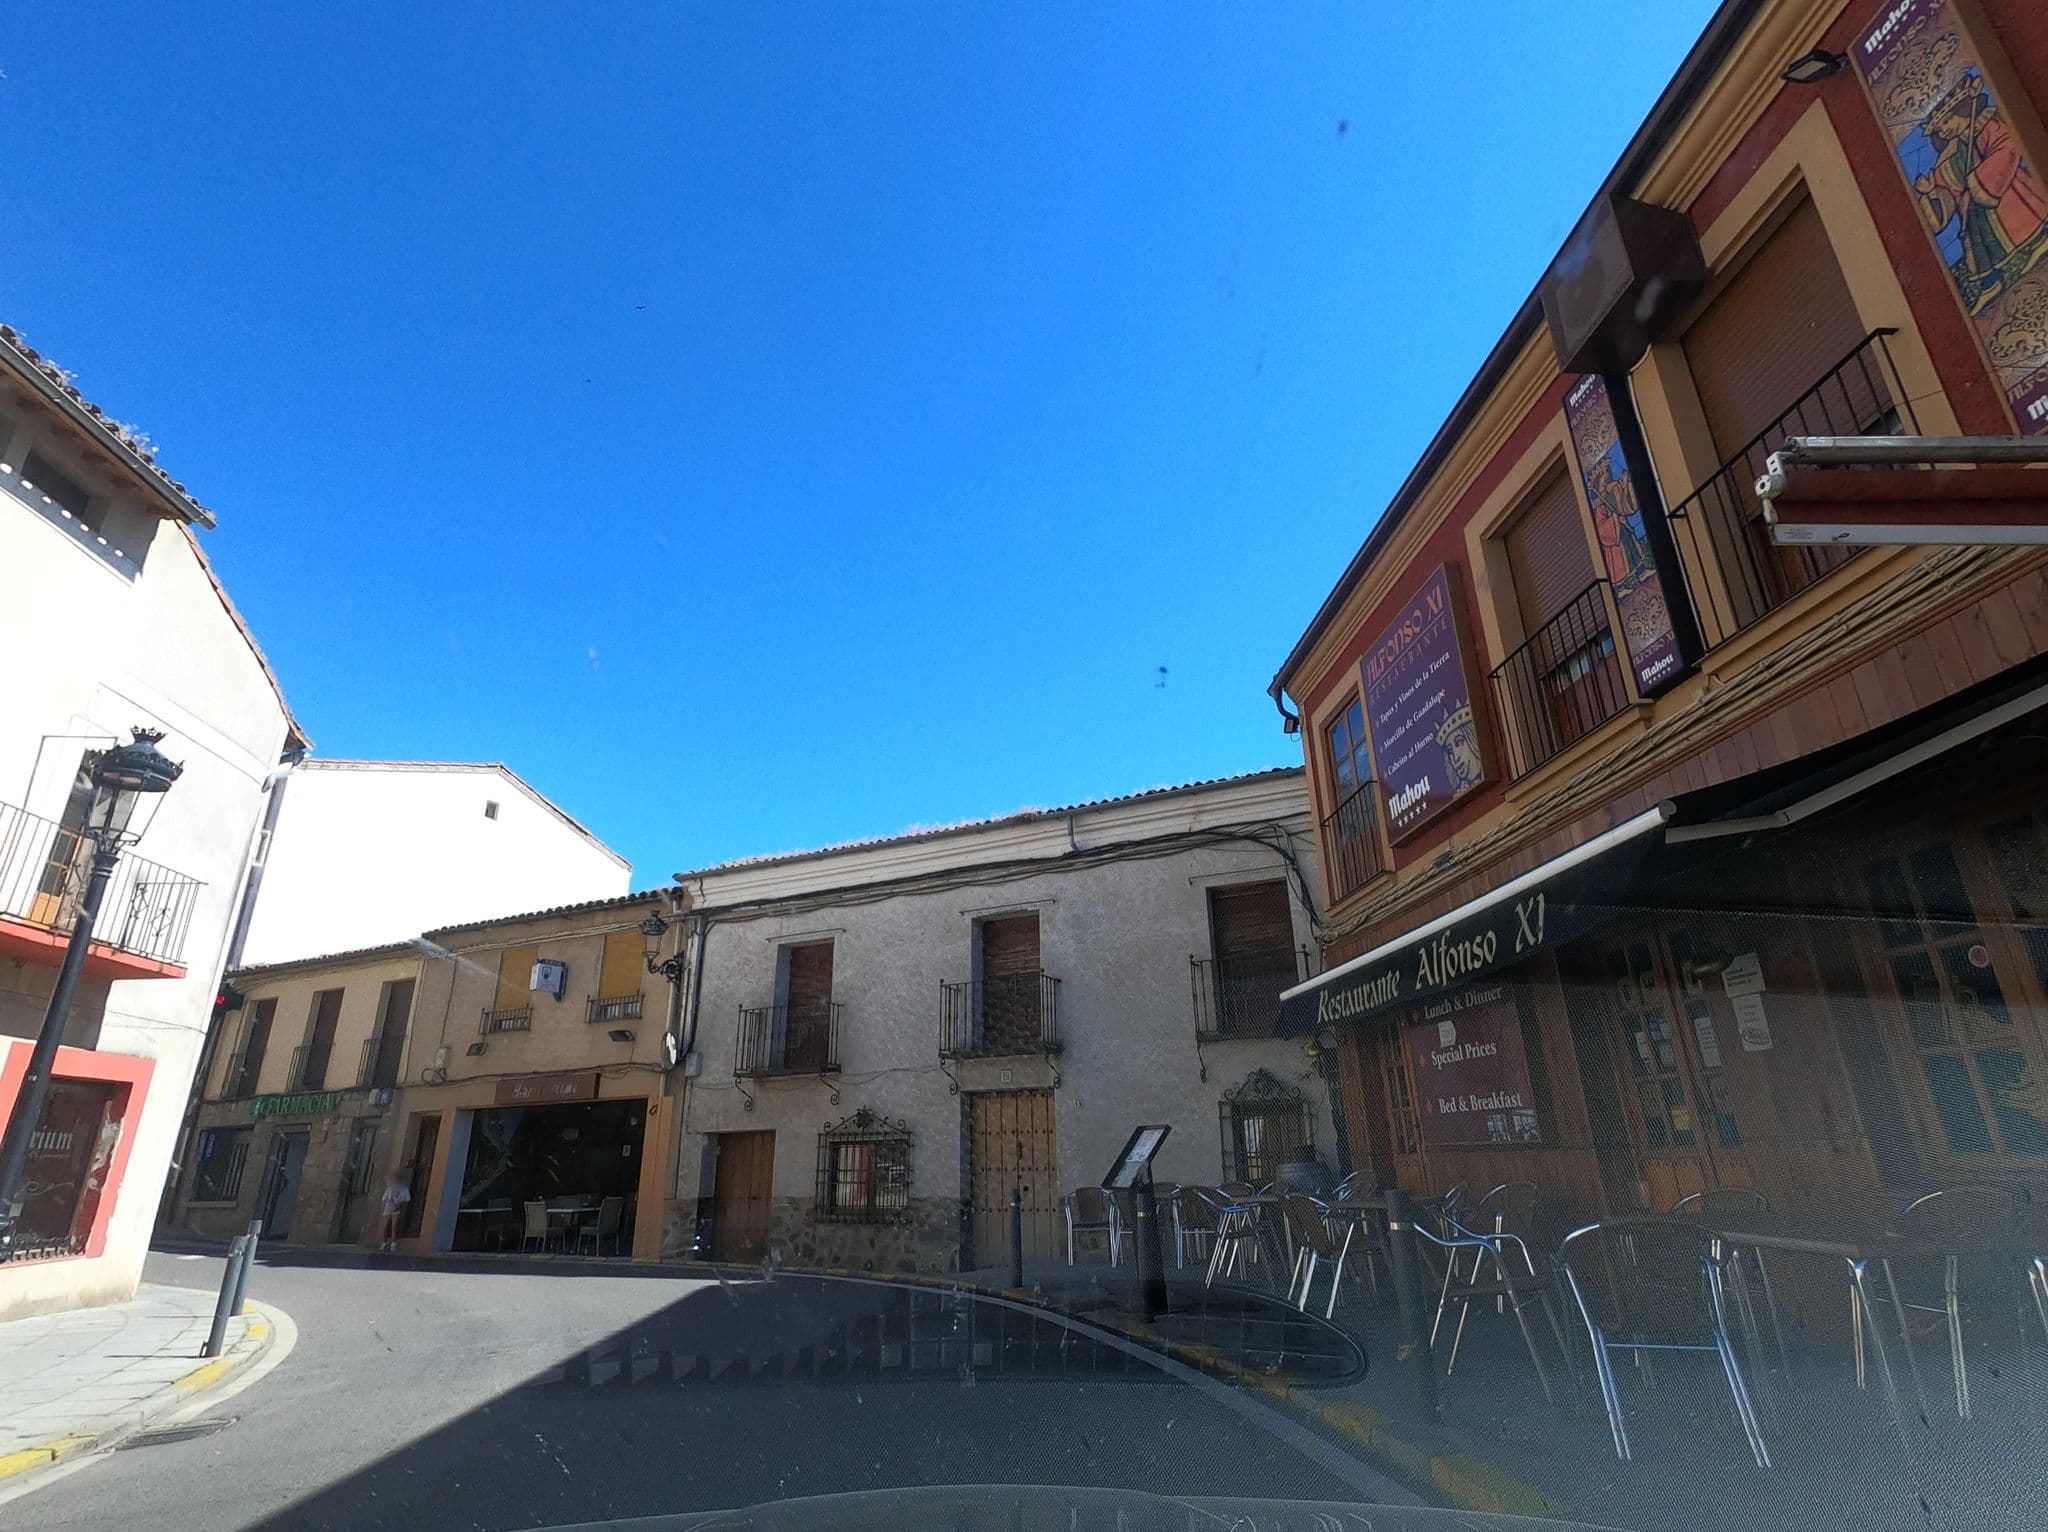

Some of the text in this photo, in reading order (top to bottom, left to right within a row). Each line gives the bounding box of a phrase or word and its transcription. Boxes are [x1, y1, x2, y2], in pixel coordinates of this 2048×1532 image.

[1864, 0, 1912, 54] Maho
[1569, 374, 1596, 407] Mahou
[1367, 584, 1444, 687] ALFONSO XI
[1369, 616, 1448, 705] RESTAURANTE
[1641, 653, 1674, 682] Mahou
[1379, 705, 1395, 725] Tapas
[1398, 685, 1415, 705] Vinos
[1414, 677, 1423, 689] de
[1422, 671, 1430, 681] la
[1429, 651, 1450, 674] Tierra
[1383, 688, 1446, 750] Morcilla de Guadalupe
[1408, 746, 1415, 760] al
[1414, 731, 1435, 754] Horno
[1388, 775, 1431, 819] Mahou
[1317, 892, 1546, 1025] Restaurante Alfonso XI
[1424, 986, 1502, 1019] Lunch & Dinner
[1431, 1041, 1497, 1070] Special Prices
[267, 1092, 331, 1117] FARMACIA
[1438, 1090, 1524, 1114] Bed & Breakfast
